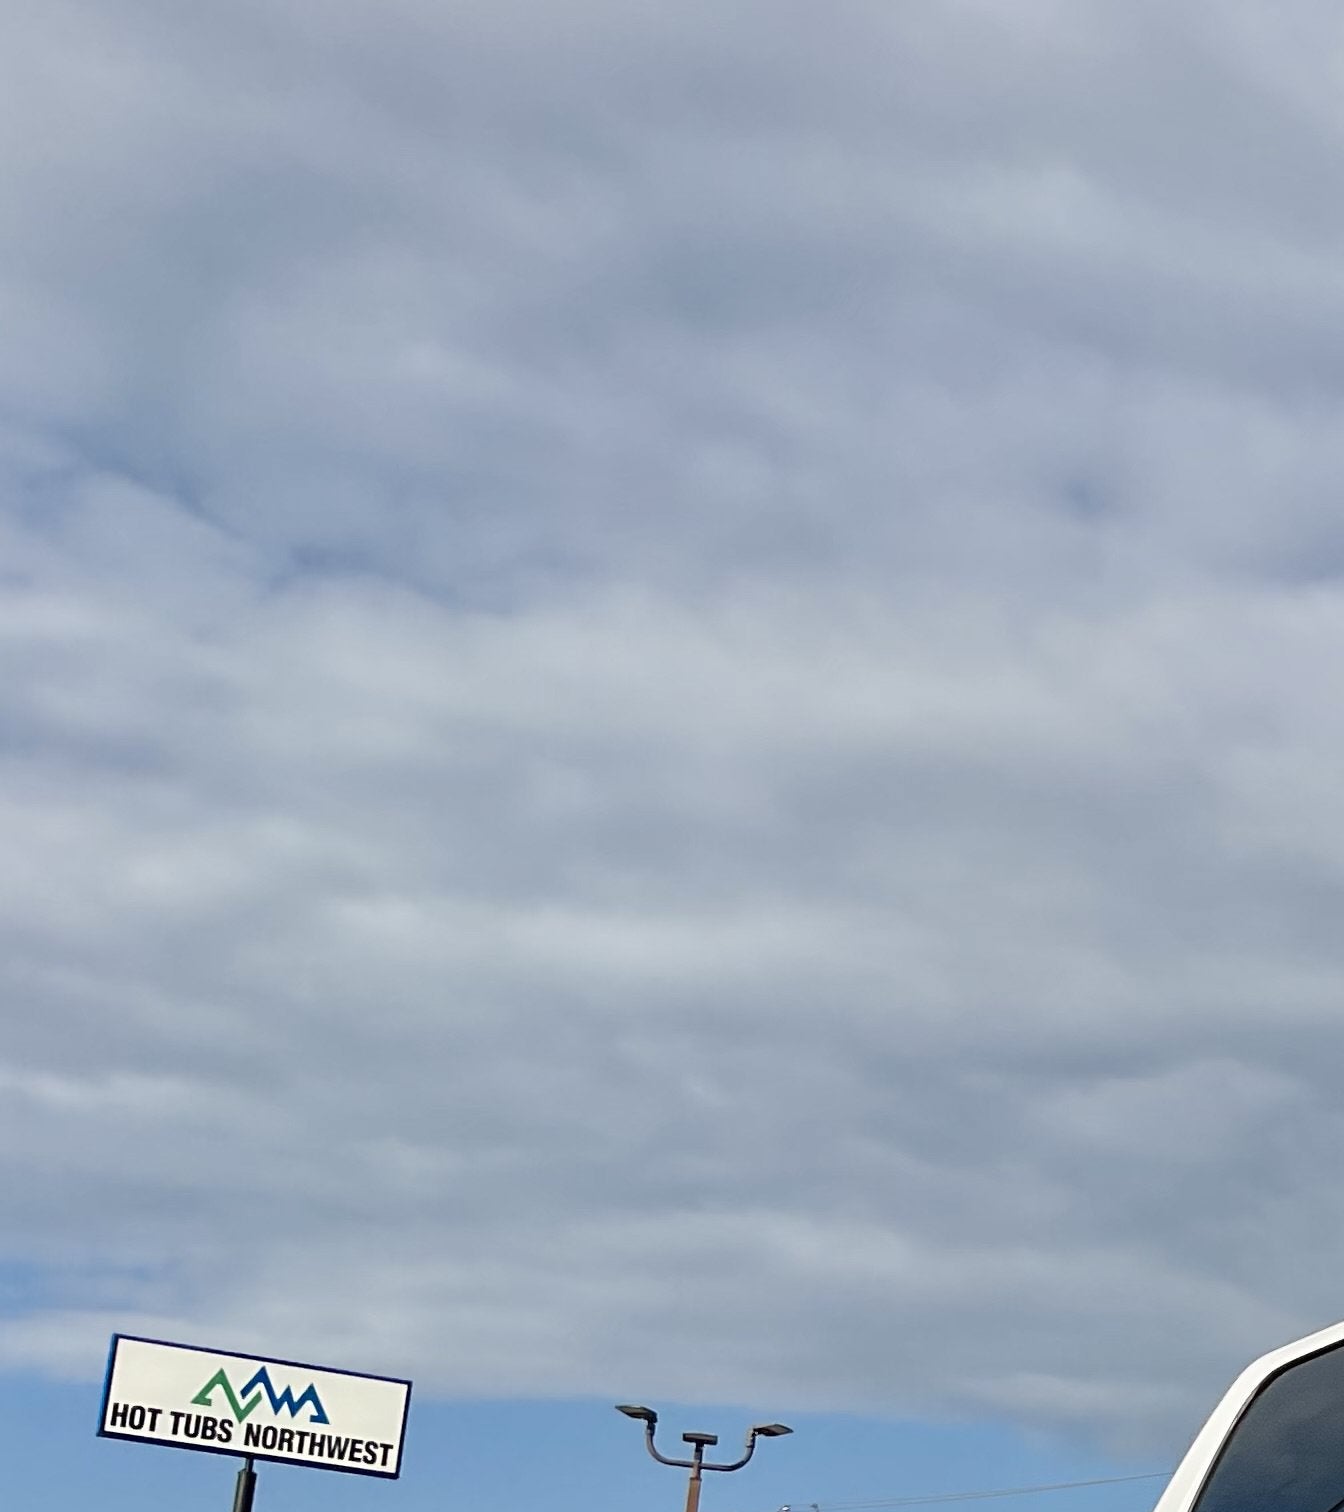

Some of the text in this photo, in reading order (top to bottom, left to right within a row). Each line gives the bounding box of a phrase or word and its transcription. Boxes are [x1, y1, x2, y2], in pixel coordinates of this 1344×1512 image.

[110, 1402, 393, 1466] HOT TUBS NORTHWEST
